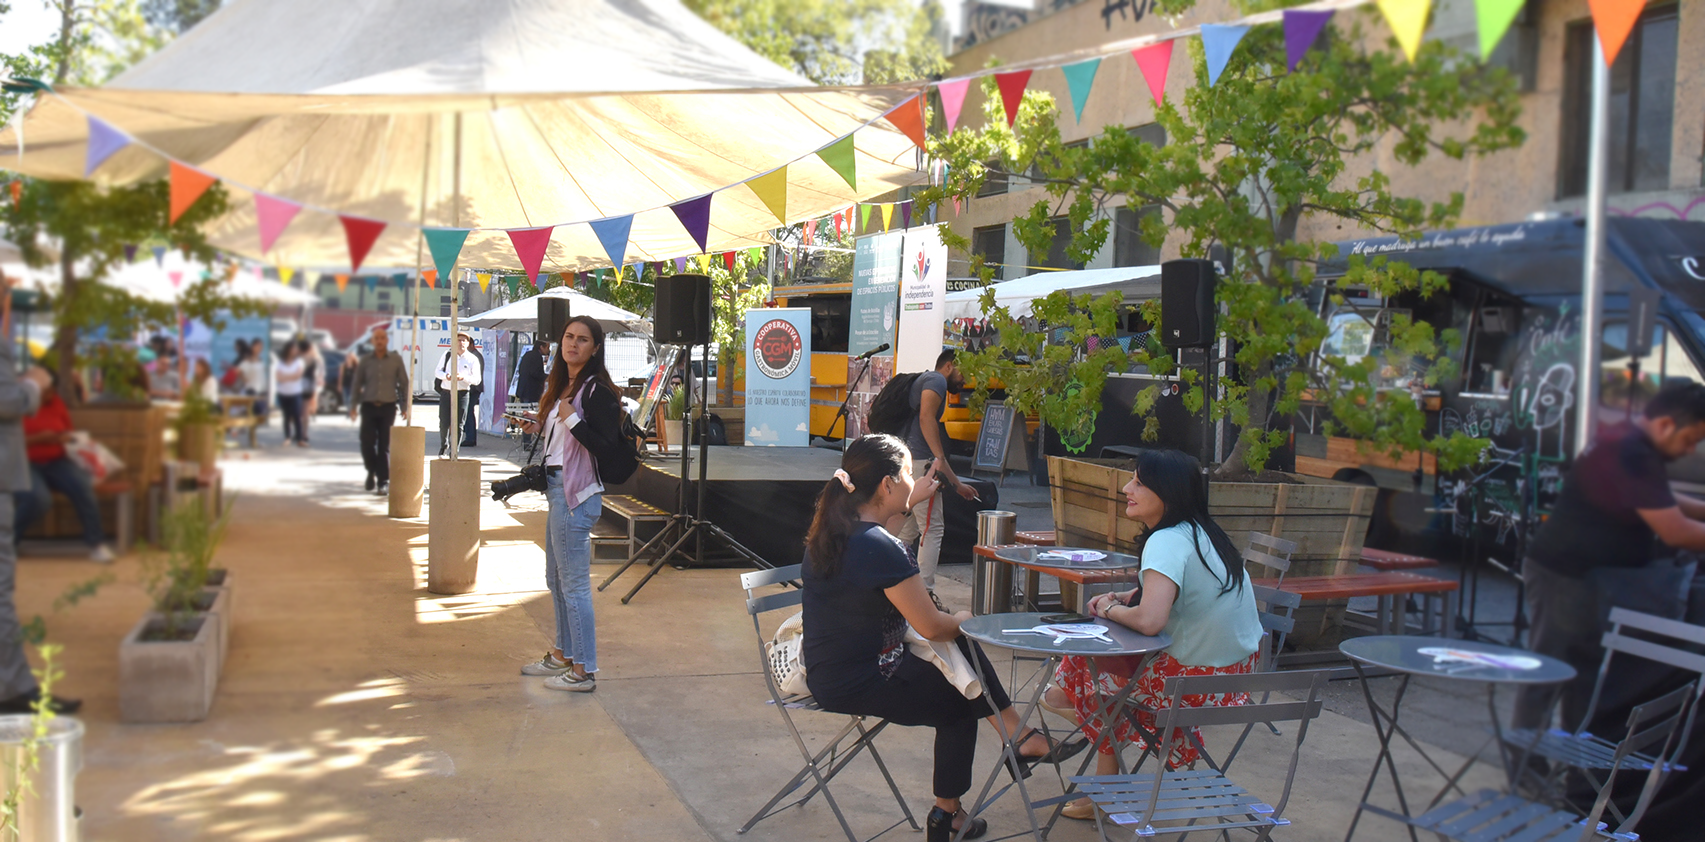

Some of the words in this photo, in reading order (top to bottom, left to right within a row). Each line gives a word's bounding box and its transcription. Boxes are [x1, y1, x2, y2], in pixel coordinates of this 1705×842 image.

[1363, 244, 1378, 257] que
[1378, 238, 1416, 252] madruga
[954, 281, 980, 291] COCINA
[758, 321, 798, 341] COOPERATIVA
[763, 342, 792, 356] CGM
[755, 350, 788, 377] GASTRONÓMICA
[754, 397, 763, 406] QUE
[765, 397, 779, 406] AHORA
[781, 398, 790, 407] NOS
[791, 398, 807, 407] DEFINE
